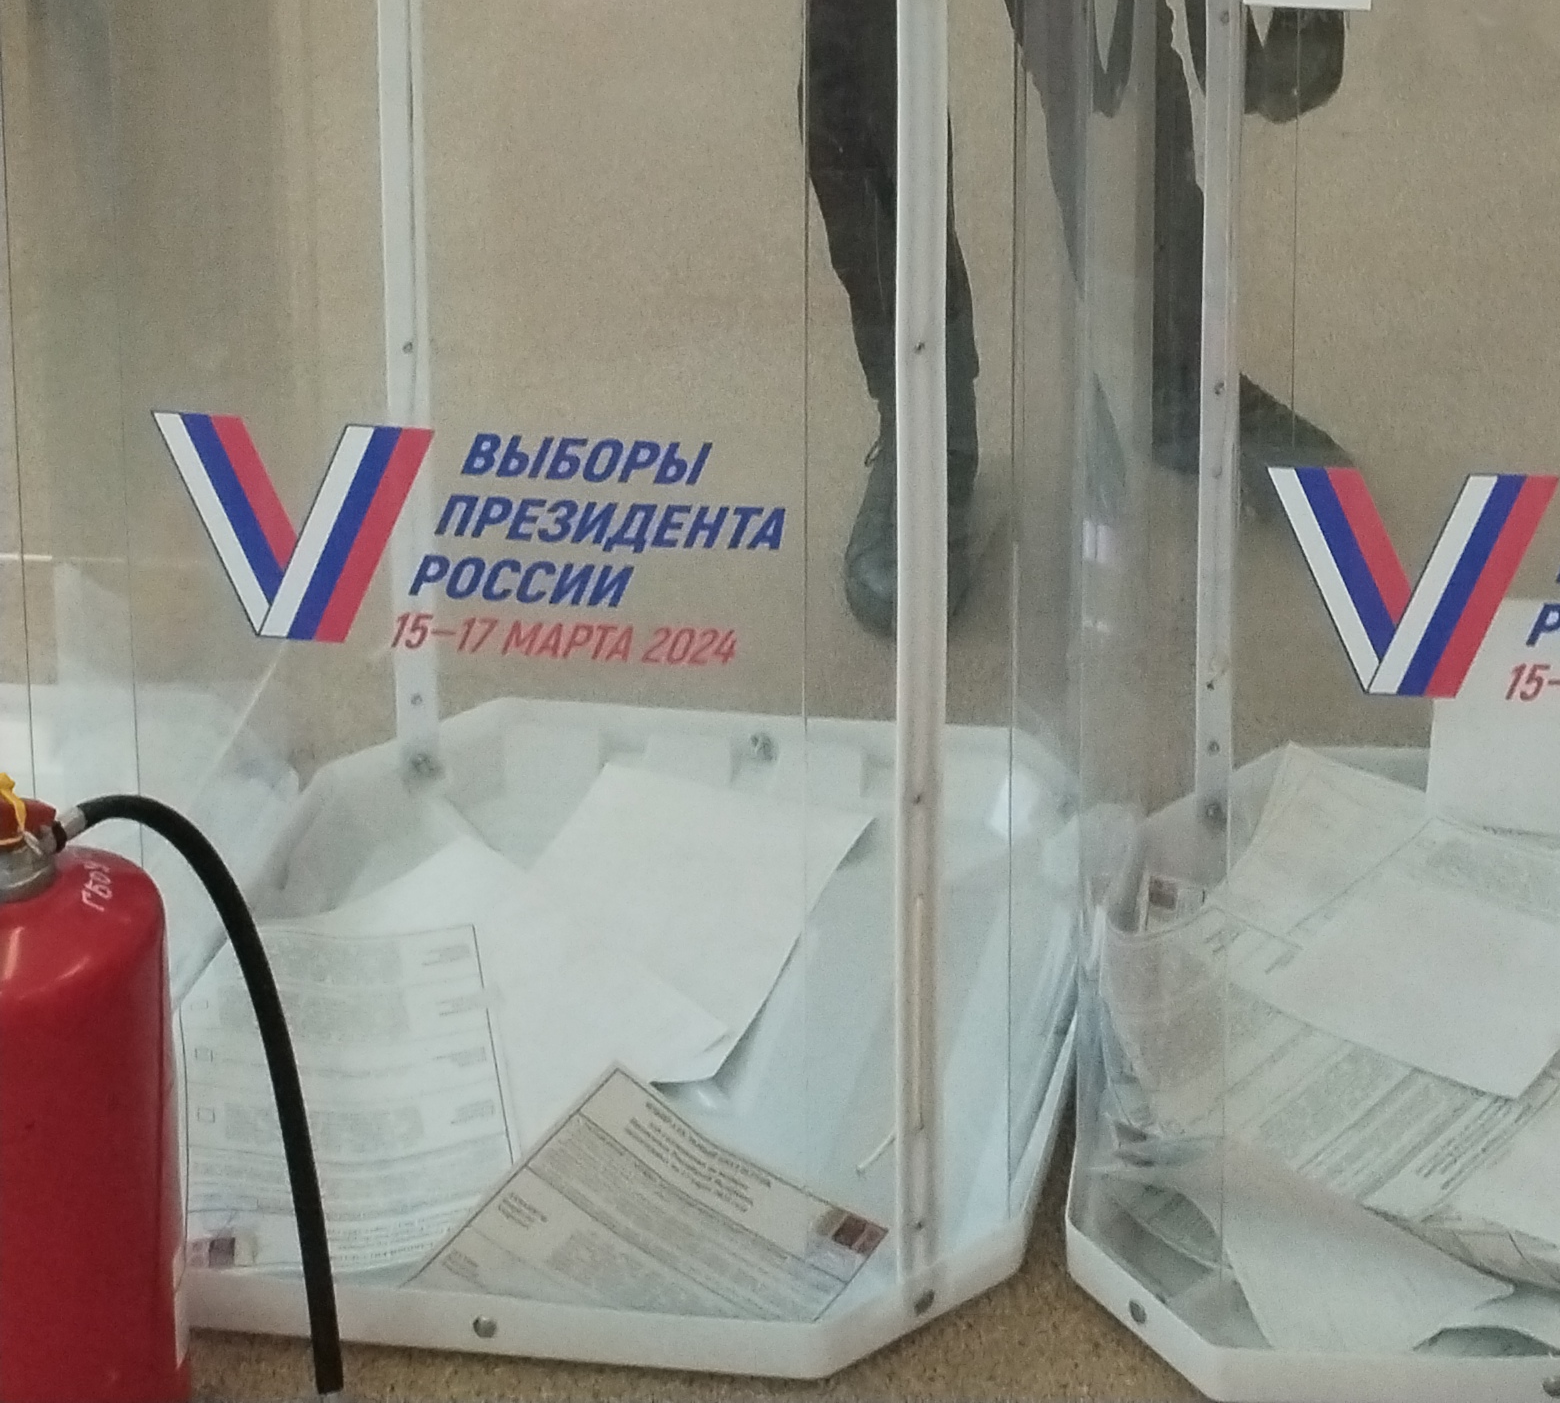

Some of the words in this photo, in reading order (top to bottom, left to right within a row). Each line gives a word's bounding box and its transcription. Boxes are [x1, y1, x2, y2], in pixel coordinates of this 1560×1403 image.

[460, 432, 714, 486] ВЫБОРЫ
[434, 493, 786, 554] ПРЕЗИДЕНТА
[408, 554, 635, 608] РОССИИ
[501, 619, 635, 664] МАРТА
[641, 627, 739, 666] 2024
